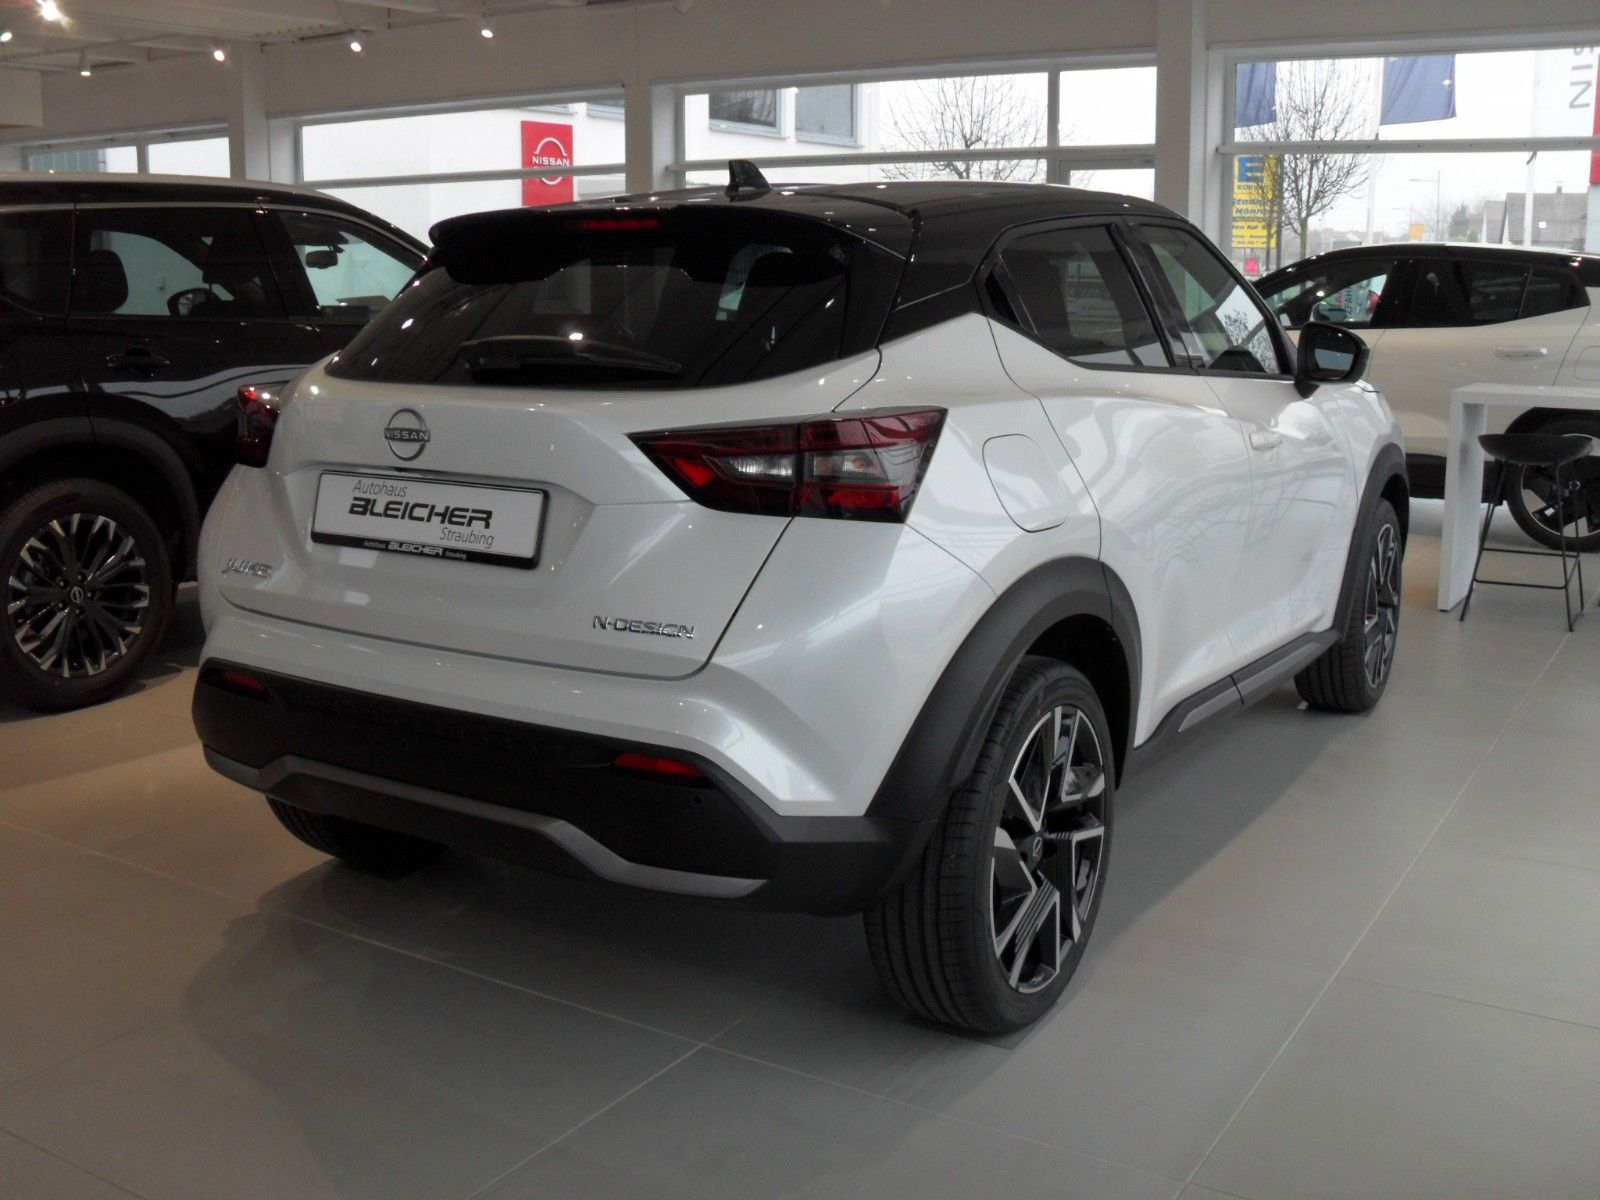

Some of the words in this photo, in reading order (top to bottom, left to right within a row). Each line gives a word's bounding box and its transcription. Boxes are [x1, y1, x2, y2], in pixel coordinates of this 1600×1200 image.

[532, 156, 570, 166] NISSAN
[384, 428, 430, 441] NISSAN
[352, 480, 408, 498] Autohaus
[348, 496, 493, 529] BLEICHER
[439, 527, 495, 549] Straubing
[388, 541, 443, 556] BLEICHER
[593, 615, 696, 639] N-DESIGN
